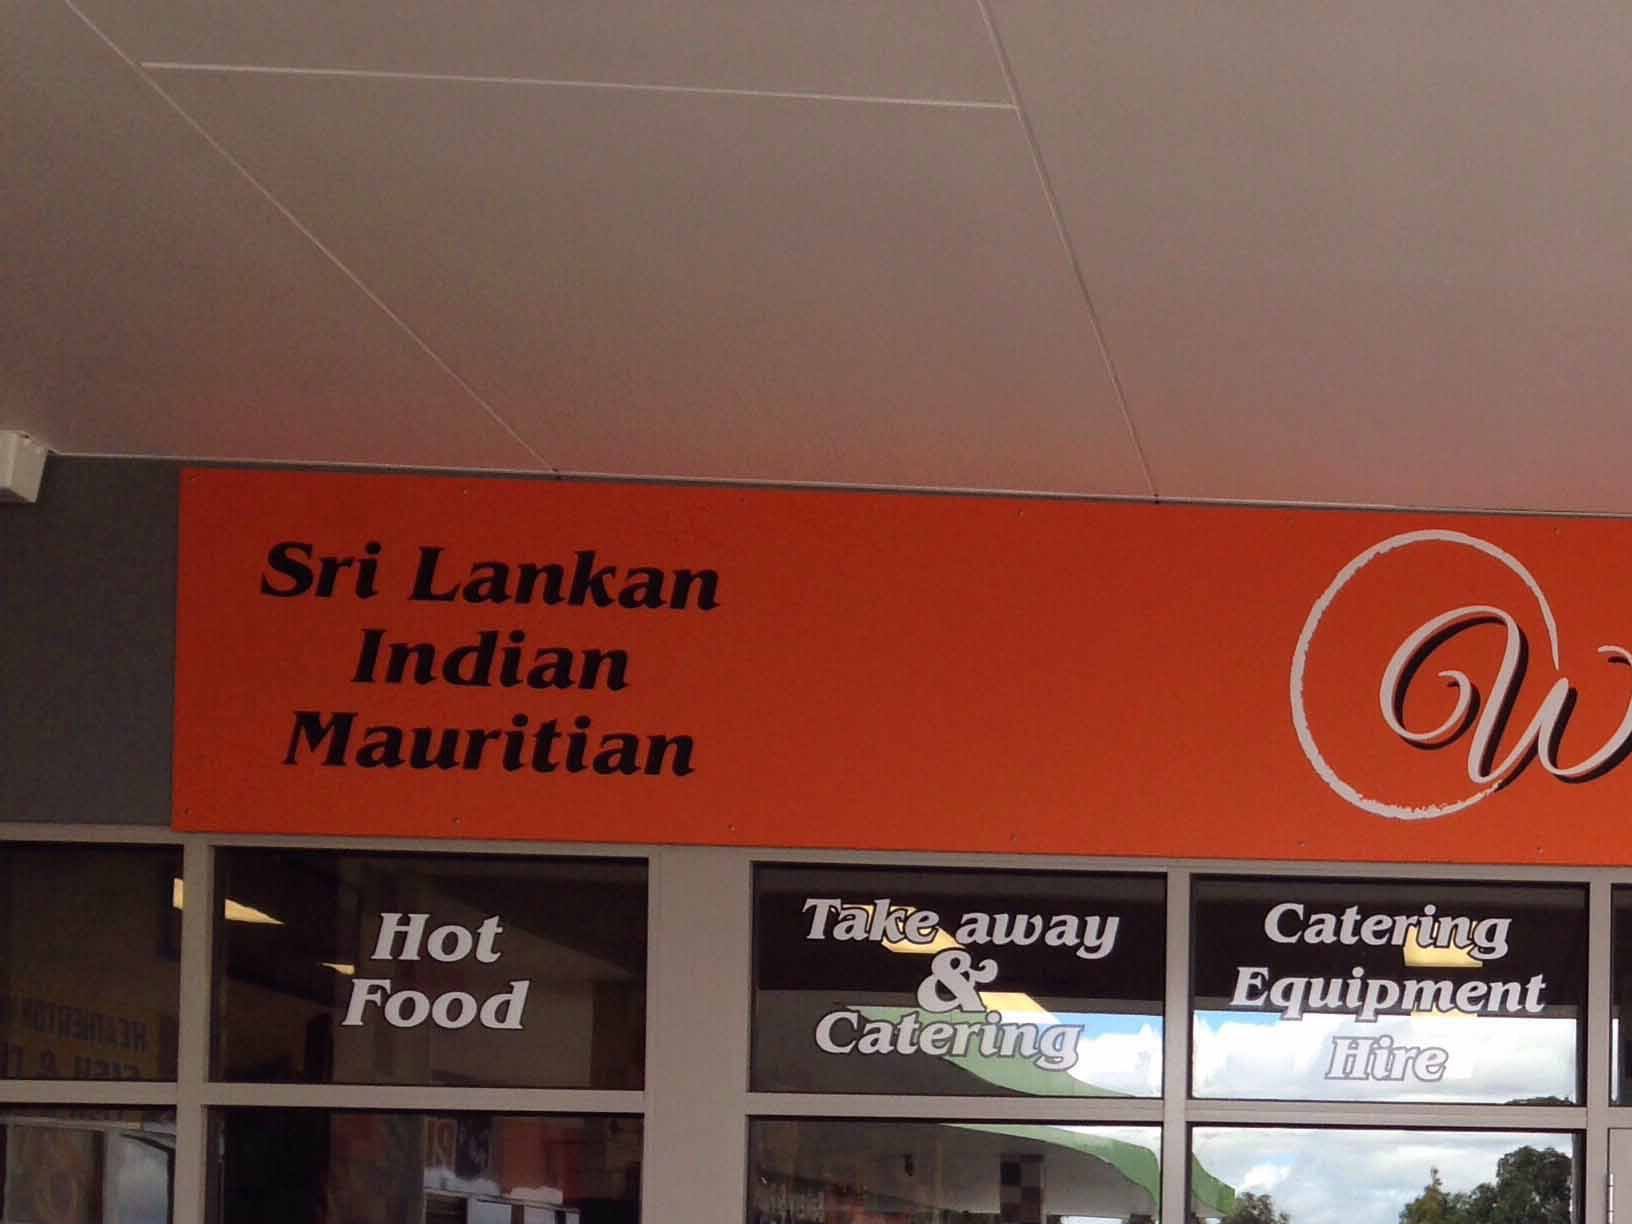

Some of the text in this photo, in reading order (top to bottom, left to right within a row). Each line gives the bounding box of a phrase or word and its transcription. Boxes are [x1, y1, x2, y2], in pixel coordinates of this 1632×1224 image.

[260, 541, 720, 610] Sri Lankan
[351, 628, 630, 692] Indian
[282, 711, 696, 778] Mauritian
[370, 913, 503, 963] Hot
[802, 897, 1120, 960] Take away
[1264, 902, 1512, 960] Catering
[341, 980, 529, 1031] Food
[916, 948, 999, 1014] &
[1231, 966, 1546, 1023] Equipment
[815, 1011, 1084, 1071] Catering
[1326, 1036, 1449, 1083] Hire
